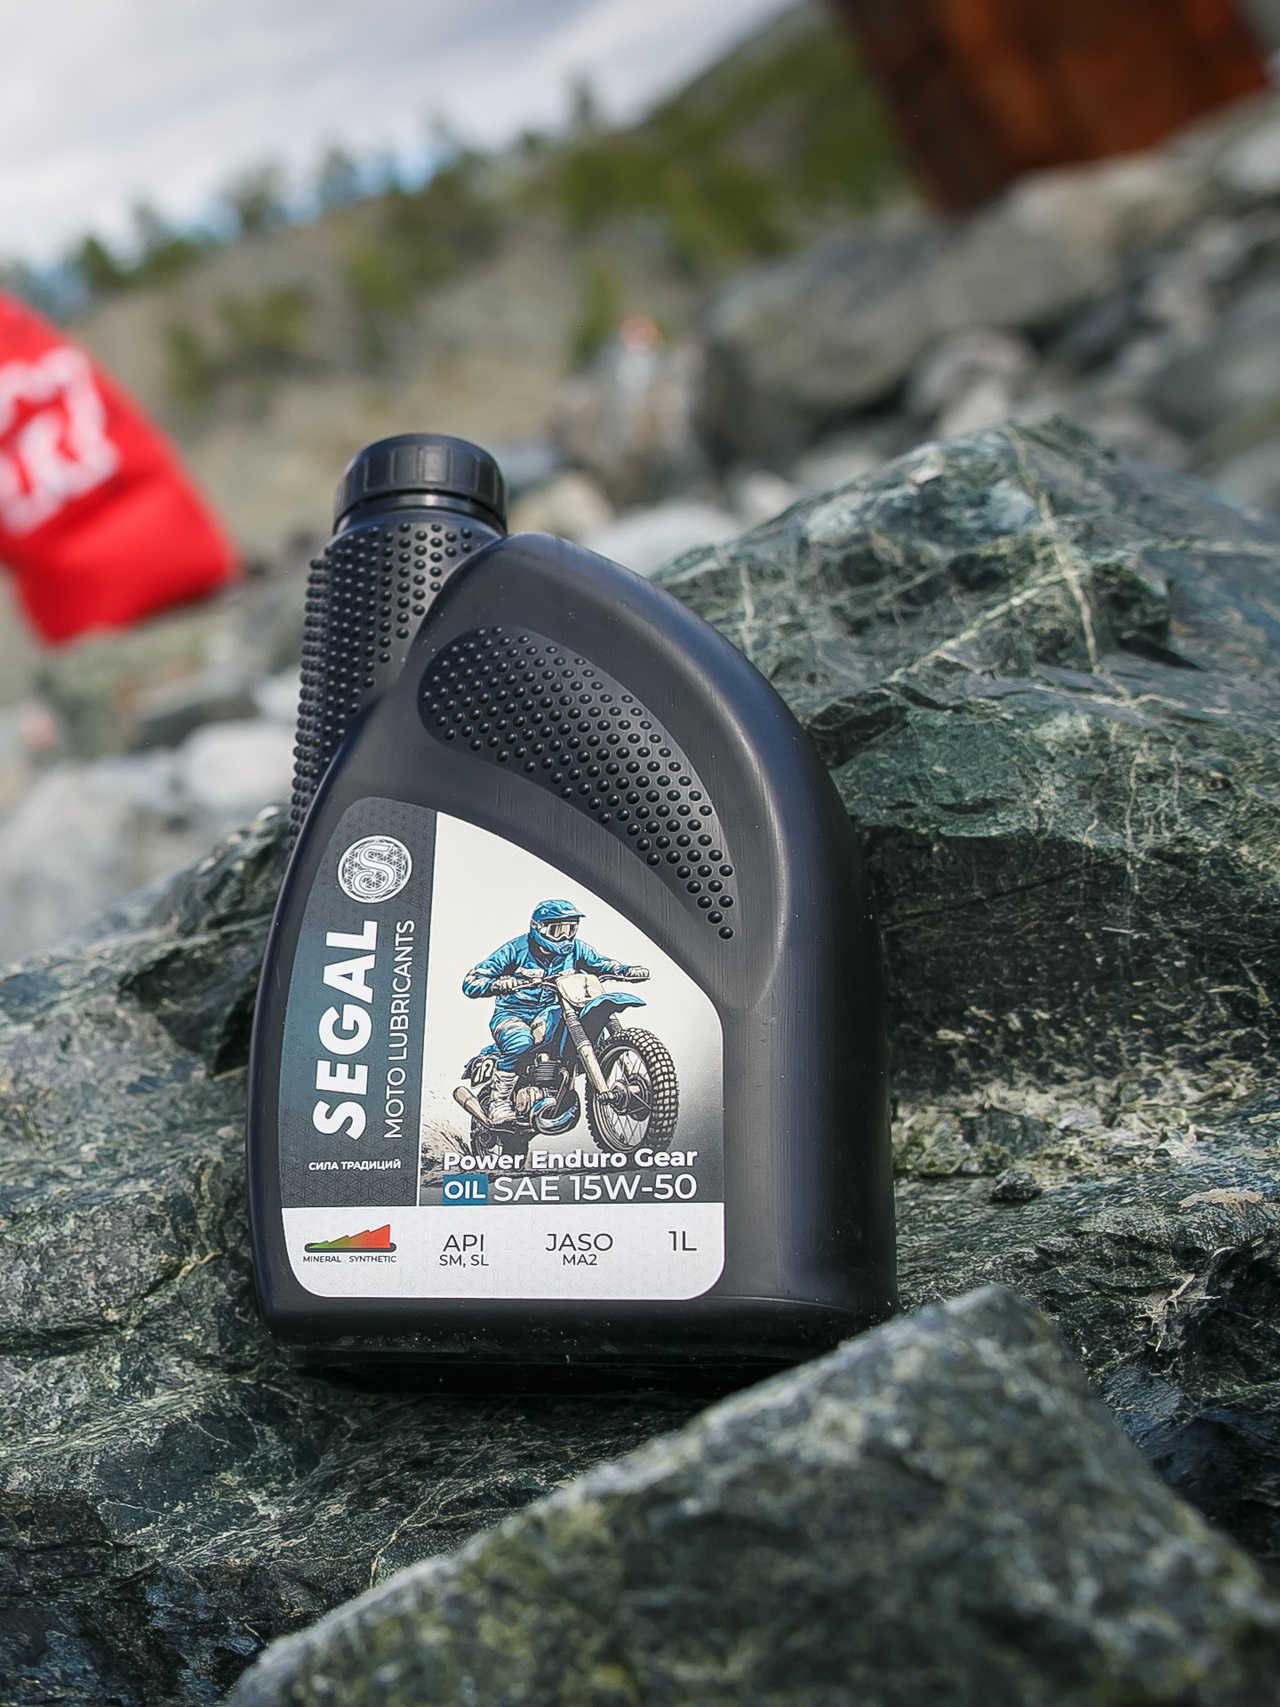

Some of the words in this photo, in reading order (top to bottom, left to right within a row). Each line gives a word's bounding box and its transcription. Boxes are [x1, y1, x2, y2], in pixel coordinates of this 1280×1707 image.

[388, 919, 416, 1061] LUBRICANTS
[312, 919, 378, 1140] SEGAL
[384, 1066, 406, 1139] MOTO
[308, 1162, 339, 1171] СИЛА
[341, 1158, 402, 1171] ТРАДИЦИЙ
[444, 1152, 523, 1171] Power
[532, 1149, 627, 1169] Enduro
[634, 1148, 698, 1167] Gear
[444, 1180, 487, 1200] OIL
[493, 1176, 560, 1201] SAE
[570, 1174, 698, 1200] 15W-50
[442, 1234, 485, 1252] API
[545, 1233, 614, 1252] JASO
[668, 1231, 698, 1252] 1L
[302, 1255, 342, 1264] MINERAL
[349, 1255, 397, 1264] SYNTHETIC
[438, 1254, 467, 1269] SM,
[470, 1254, 490, 1268] SL
[562, 1253, 598, 1266] MA2
